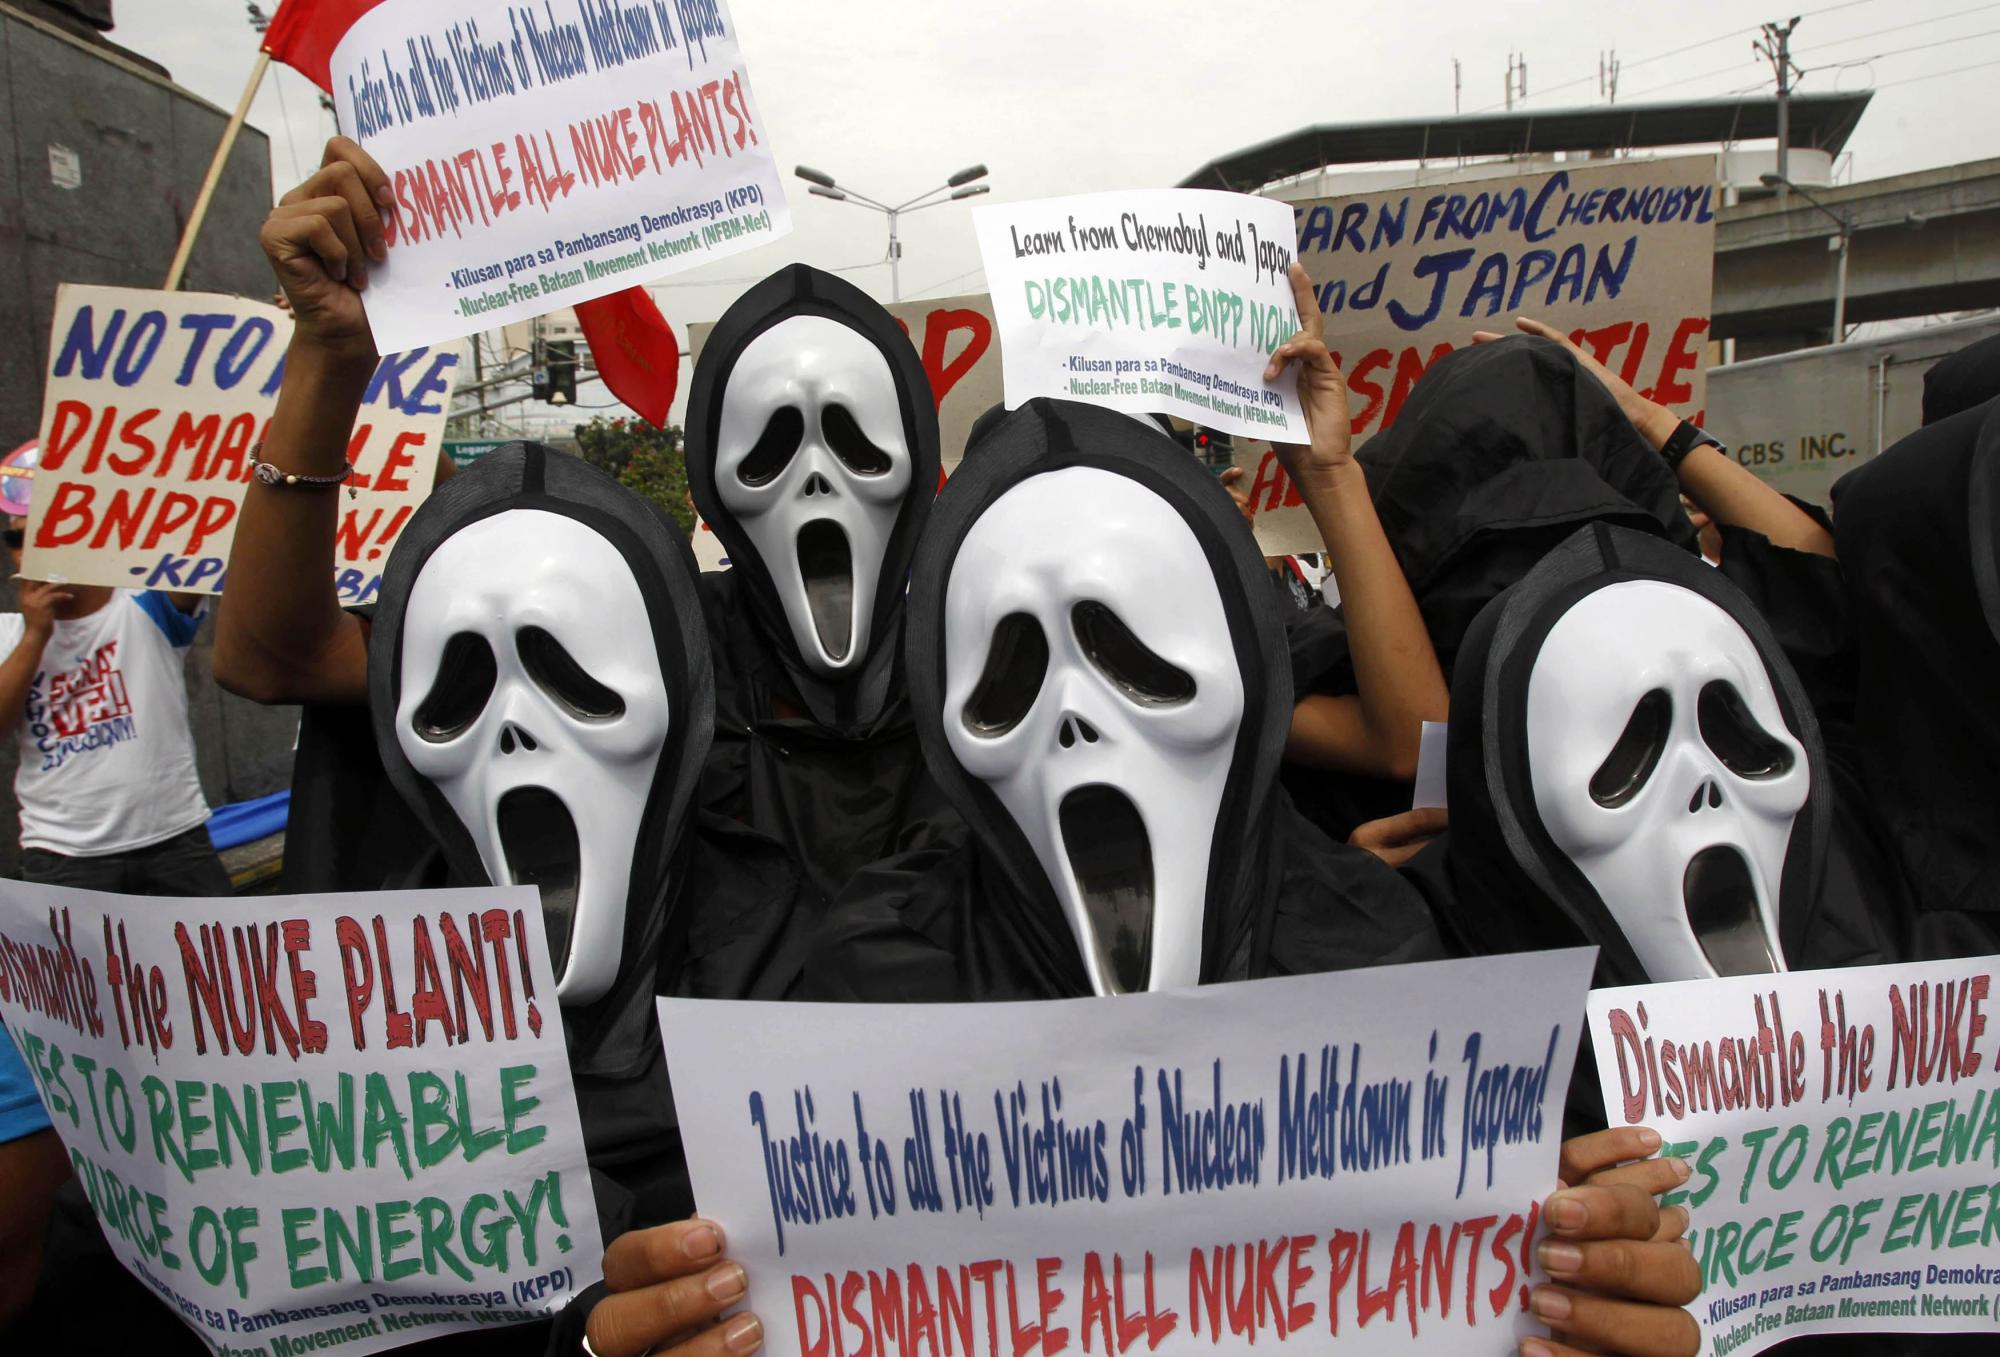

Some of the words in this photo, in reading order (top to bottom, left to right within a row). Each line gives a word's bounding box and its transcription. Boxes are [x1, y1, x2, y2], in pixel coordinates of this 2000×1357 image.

[407, 36, 436, 118] all
[420, 34, 459, 119] the
[445, 15, 516, 106] Victims
[508, 4, 533, 90] of
[521, 0, 588, 86] Nuclear
[349, 56, 392, 147] Justice
[382, 49, 413, 127] to
[514, 129, 575, 214] ALL
[568, 107, 646, 189] NUKE
[637, 69, 758, 176] PLANTS!
[450, 263, 504, 290] Kilusan
[504, 253, 537, 279] para
[537, 248, 555, 265] sa
[555, 222, 641, 259] Pambansang
[640, 199, 724, 235] Demokrasya
[724, 183, 764, 214] (KPD)
[1010, 224, 1066, 259] Learn
[1068, 215, 1119, 252] from
[1121, 212, 1211, 270] Chernobyl
[1216, 219, 1246, 265] and
[1413, 182, 1525, 244] FROM
[1523, 170, 1715, 243] CHERNOBYL
[458, 280, 540, 318] Nuclear-Free
[538, 268, 585, 295] Bataan
[583, 246, 649, 282] Movement
[646, 230, 702, 263] Network
[701, 209, 772, 251] (NFBM-Net)
[1385, 236, 1637, 331] JAPAN
[53, 304, 168, 388] NO
[174, 313, 274, 391] TO
[1024, 275, 1182, 331] DISMANTLE
[1184, 283, 1244, 349] BNPP
[1069, 355, 1112, 372] Kilusan
[1115, 358, 1141, 376] para
[1144, 360, 1158, 372] sa
[1160, 357, 1211, 391] Pambansang
[1212, 373, 1260, 404] Demokrasya
[1260, 388, 1284, 411] (KPD)
[1069, 377, 1139, 397] Nuclear-Free
[1141, 377, 1173, 396] Bataan
[1174, 383, 1211, 409] Movement
[1211, 394, 1242, 419] Network
[1243, 404, 1288, 431] (NFBM-Net)
[40, 400, 427, 493] DISMALE
[1800, 432, 1855, 461] INC.
[33, 482, 236, 556] BNPP
[103, 913, 173, 1066] the
[174, 919, 328, 1062] NUKE
[335, 908, 543, 1051] PLANT!
[1608, 989, 1806, 1125] Dismantle
[1818, 988, 1874, 1108] the
[1887, 975, 1990, 1092] NUKE
[72, 1053, 136, 1154] TO
[140, 1064, 547, 1184] RENEWABLE
[749, 1085, 855, 1256] Justice
[853, 1090, 895, 1221] to
[904, 1088, 943, 1212] all
[941, 1089, 993, 1221] the
[994, 1075, 1109, 1208] Victims
[1120, 1065, 1146, 1197] of
[1157, 1057, 1265, 1196] Nuclear
[1279, 1042, 1412, 1186] Meltdown
[1421, 1029, 1448, 1160] in
[1456, 1023, 1561, 1199] Japan!
[1659, 1136, 1728, 1209] ES
[1740, 1124, 1810, 1205] TO
[189, 1205, 259, 1299] OF
[281, 1170, 574, 1289] ENERGY!
[1810, 1197, 1884, 1266] OF
[205, 1308, 225, 1331] sa
[226, 1299, 370, 1333] Pambansang
[371, 1289, 507, 1309] Demokrasya
[512, 1266, 573, 1307] (KPD)
[791, 1257, 1070, 1357] DISMANTLE
[1081, 1250, 1179, 1354] ALL
[1189, 1234, 1318, 1346] NUKE
[1328, 1199, 1540, 1339] PLANTS!
[1708, 1292, 1757, 1325] Kilusan
[1760, 1284, 1794, 1308] para
[1797, 1280, 1816, 1297] sa
[1819, 1270, 1922, 1293] Pambansang
[1926, 1264, 2000, 1285] Demokra
[270, 1316, 382, 1357] Movement
[380, 1311, 469, 1333] Network
[1712, 1312, 1782, 1357] Nuclear-Free
[1785, 1303, 1835, 1326] Bataan
[1837, 1294, 1917, 1318] Movement
[1921, 1293, 1989, 1317] Network
